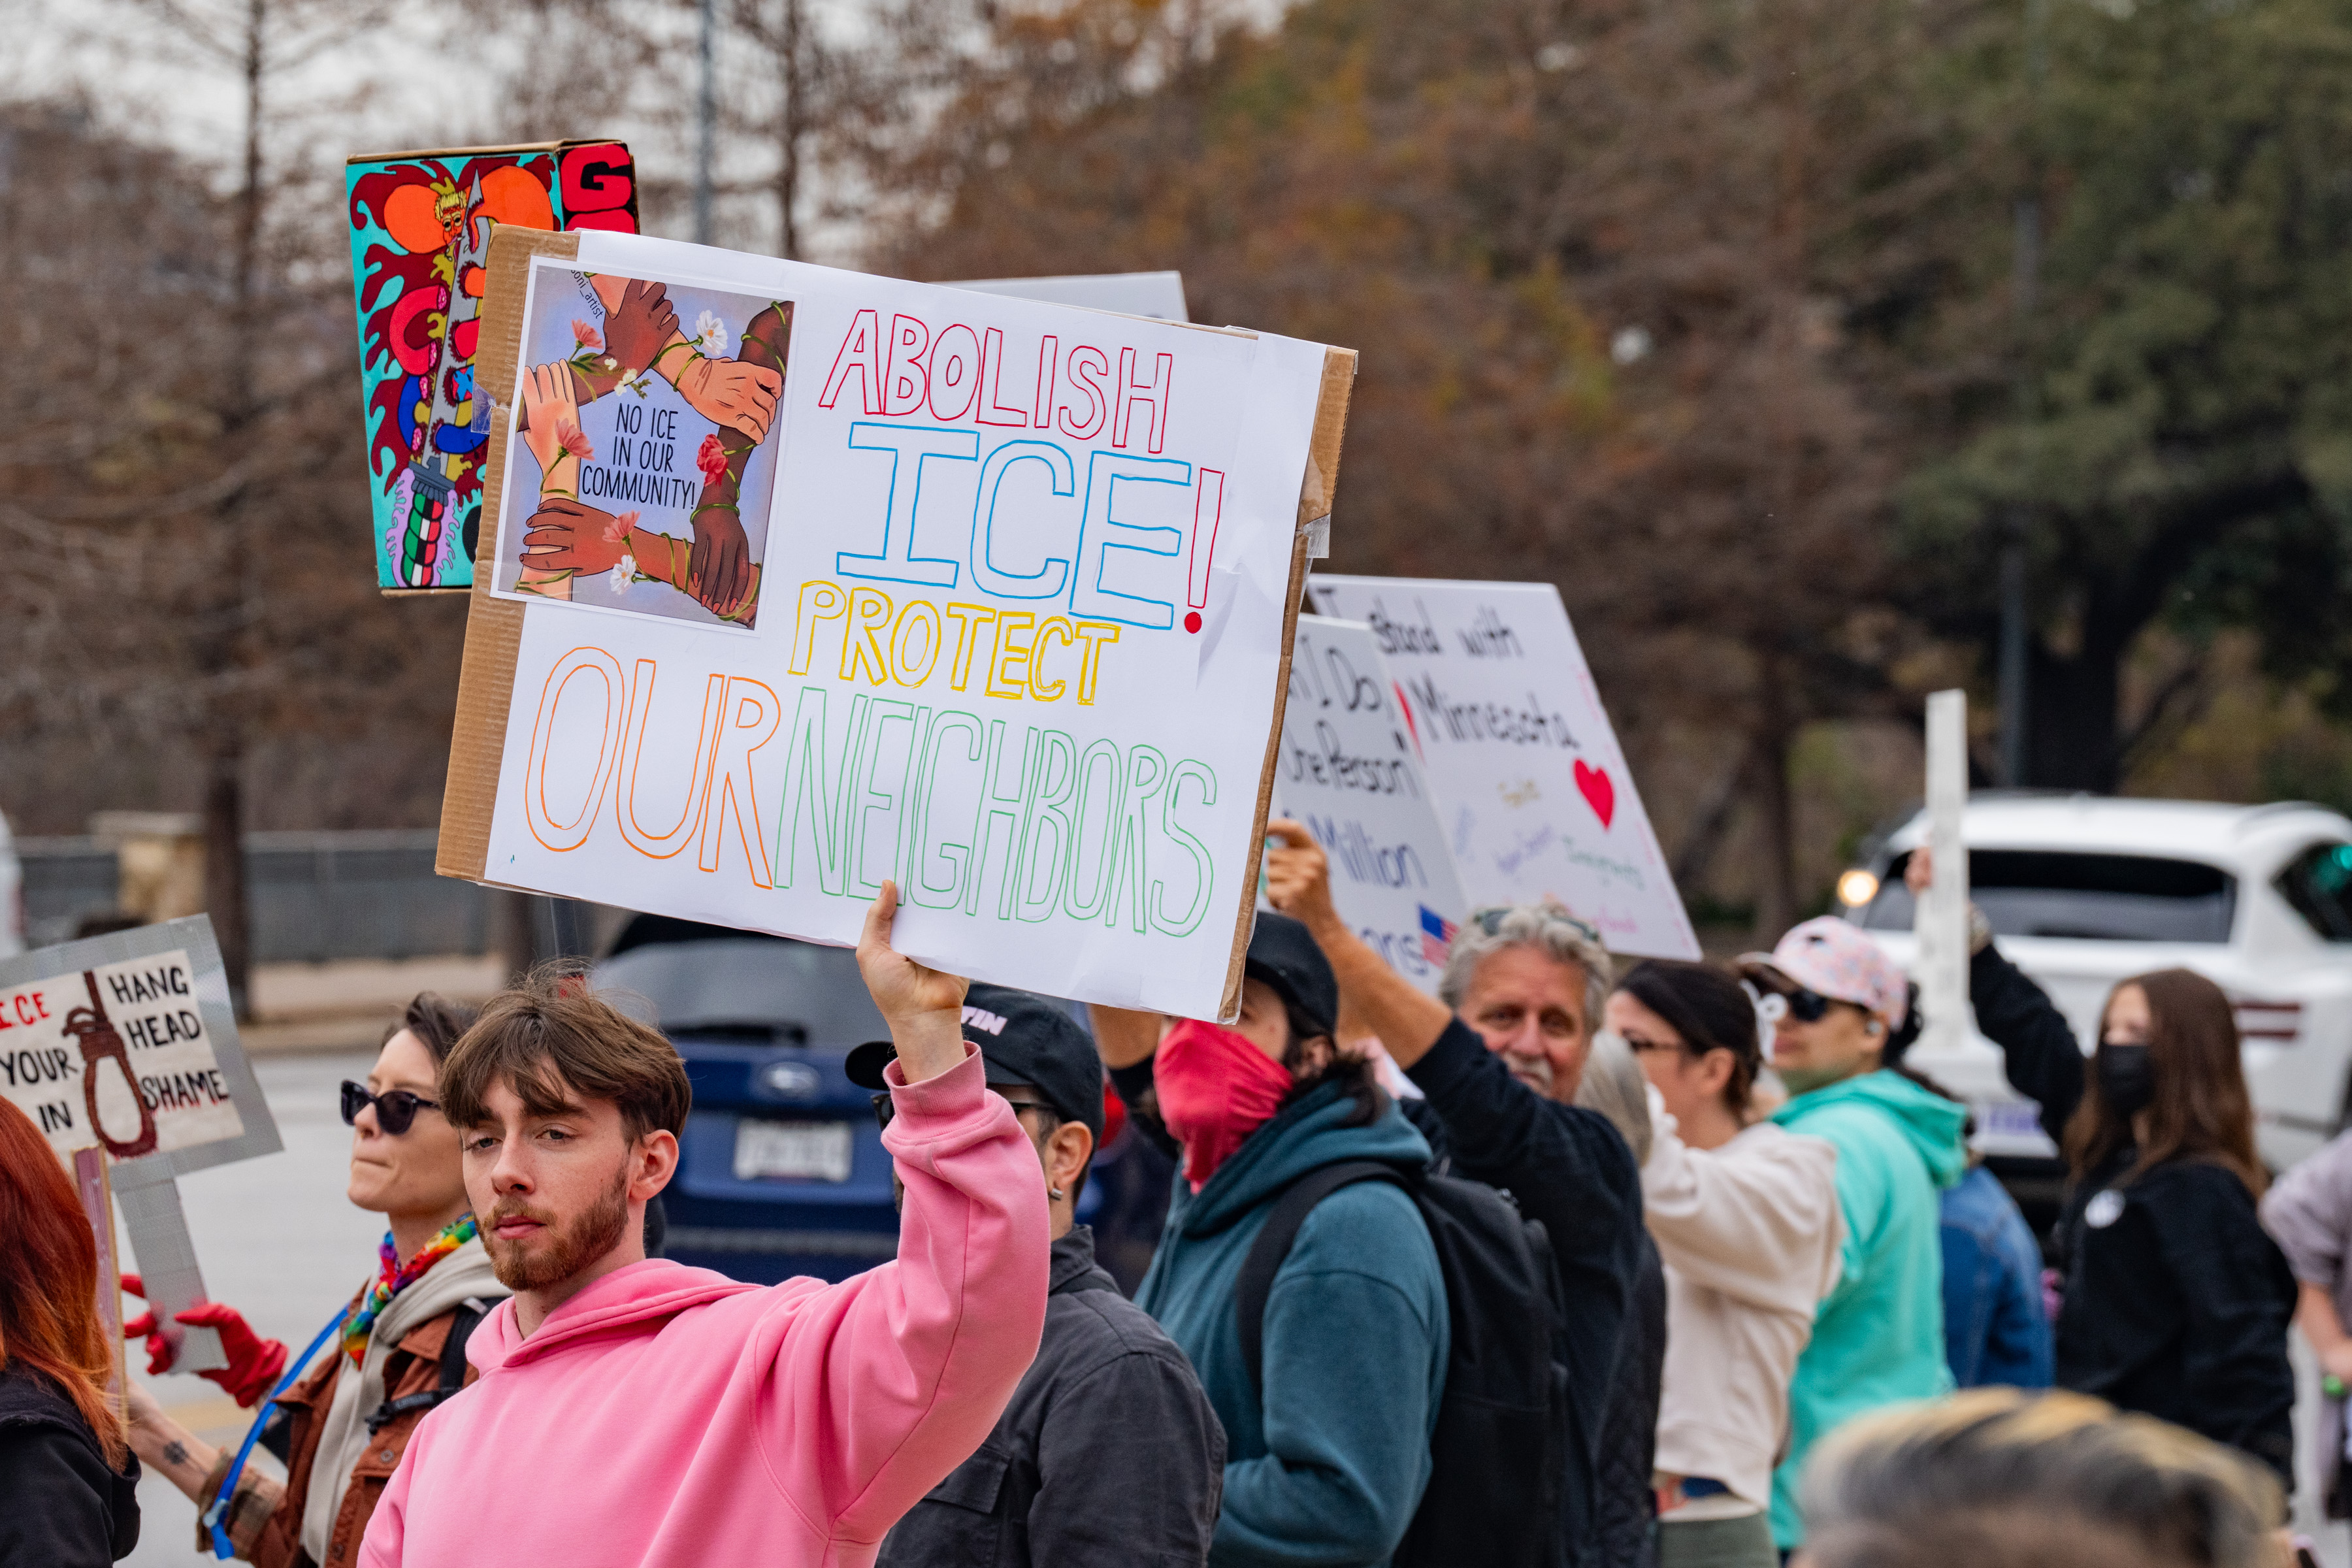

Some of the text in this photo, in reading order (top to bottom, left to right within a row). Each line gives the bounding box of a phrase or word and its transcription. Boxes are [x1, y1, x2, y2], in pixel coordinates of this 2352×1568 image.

[818, 309, 1173, 453] ABOLISH
[616, 402, 678, 440] NO ICE
[613, 436, 673, 473] IN OUR
[582, 465, 695, 510] COMMUNITY!
[837, 421, 1225, 634] ICE!
[787, 580, 1121, 706] PROTECT
[1454, 605, 1524, 657] with
[1407, 668, 1581, 750] Minnesota
[525, 646, 1218, 938] OUR NEIGHBORS
[108, 966, 191, 1004] HANG
[0, 1009, 202, 1087] YOUR HEAD
[961, 1005, 1008, 1036] IN
[37, 1069, 231, 1134] IN SHAME
